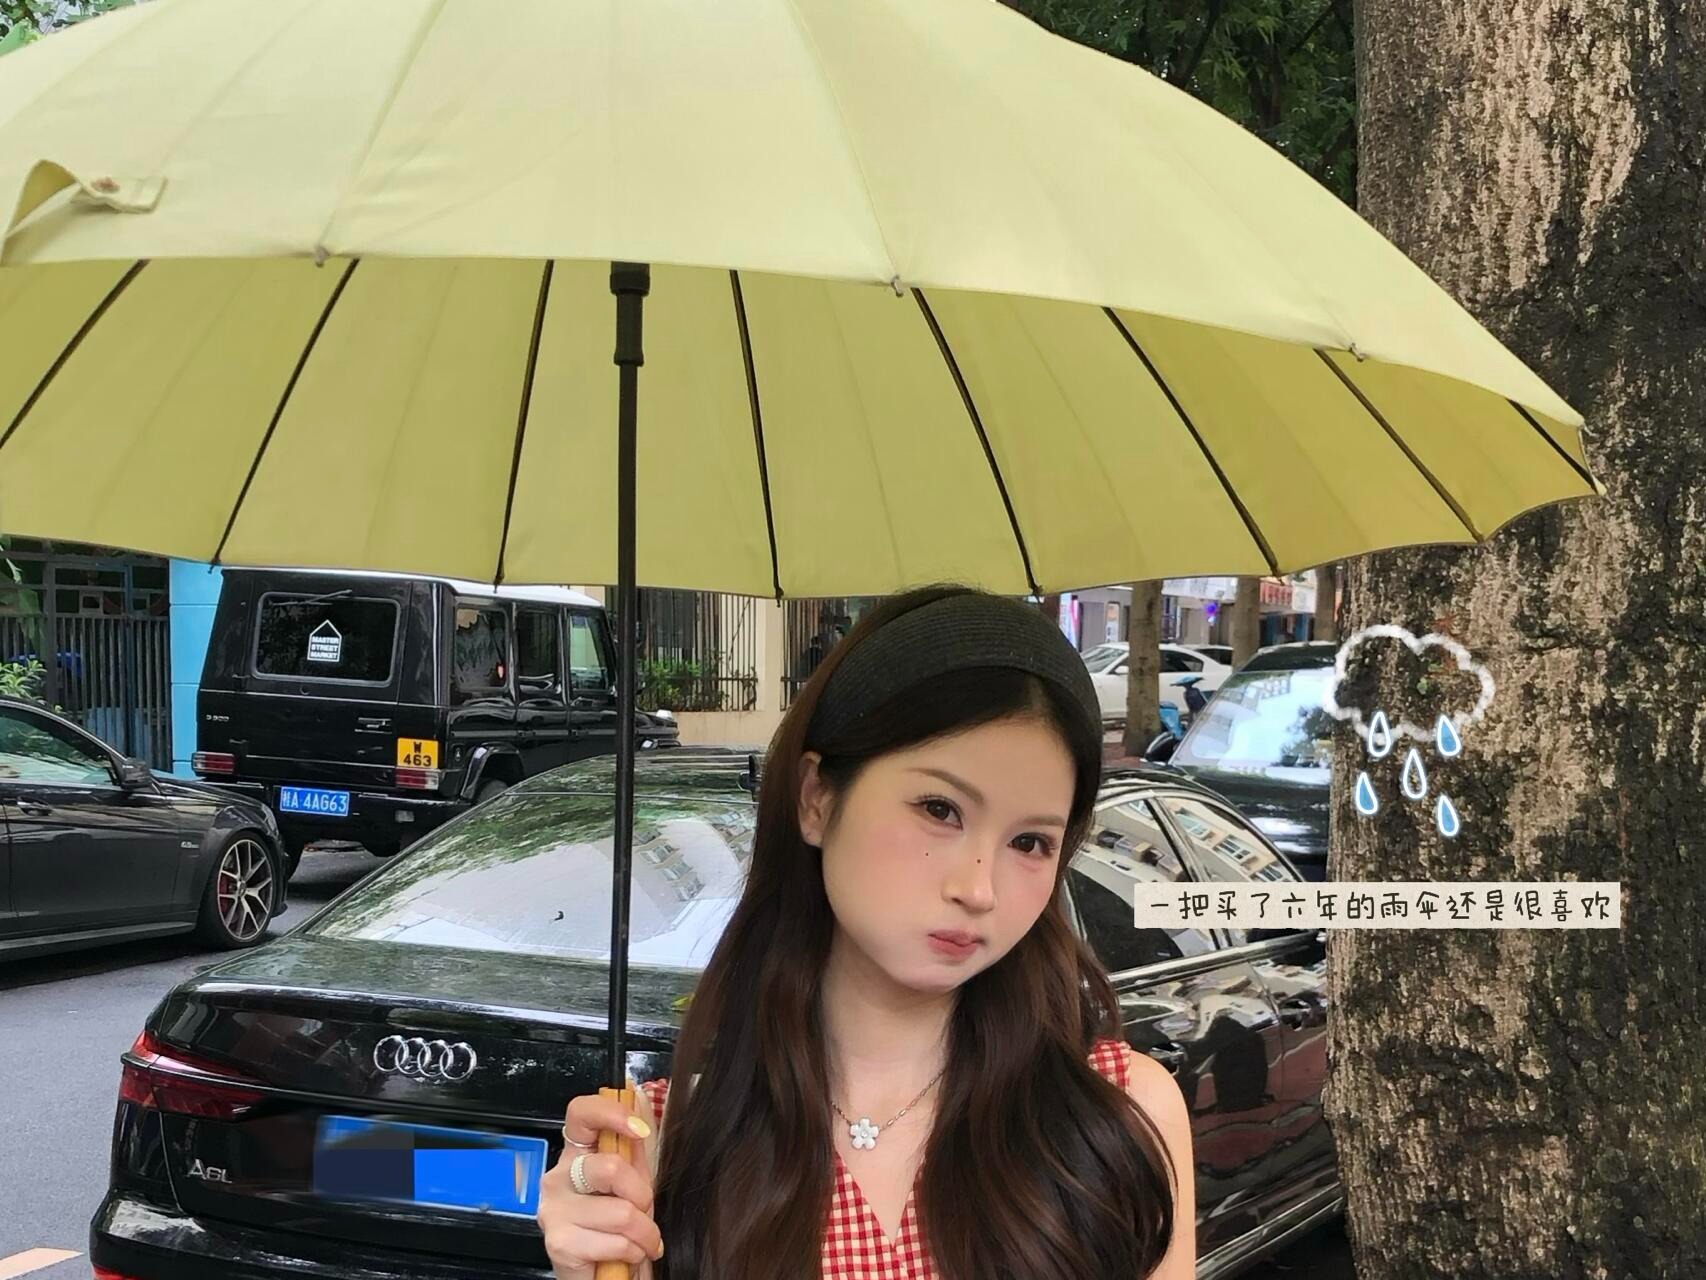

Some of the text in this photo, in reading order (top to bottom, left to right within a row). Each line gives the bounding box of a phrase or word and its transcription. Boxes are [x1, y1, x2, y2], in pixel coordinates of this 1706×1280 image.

[311, 636, 339, 645] MASTER
[311, 644, 339, 653] STREET
[413, 741, 422, 754] W
[403, 754, 432, 767] 463
[303, 792, 347, 812] 4AG63
[186, 1158, 233, 1184] A6L
